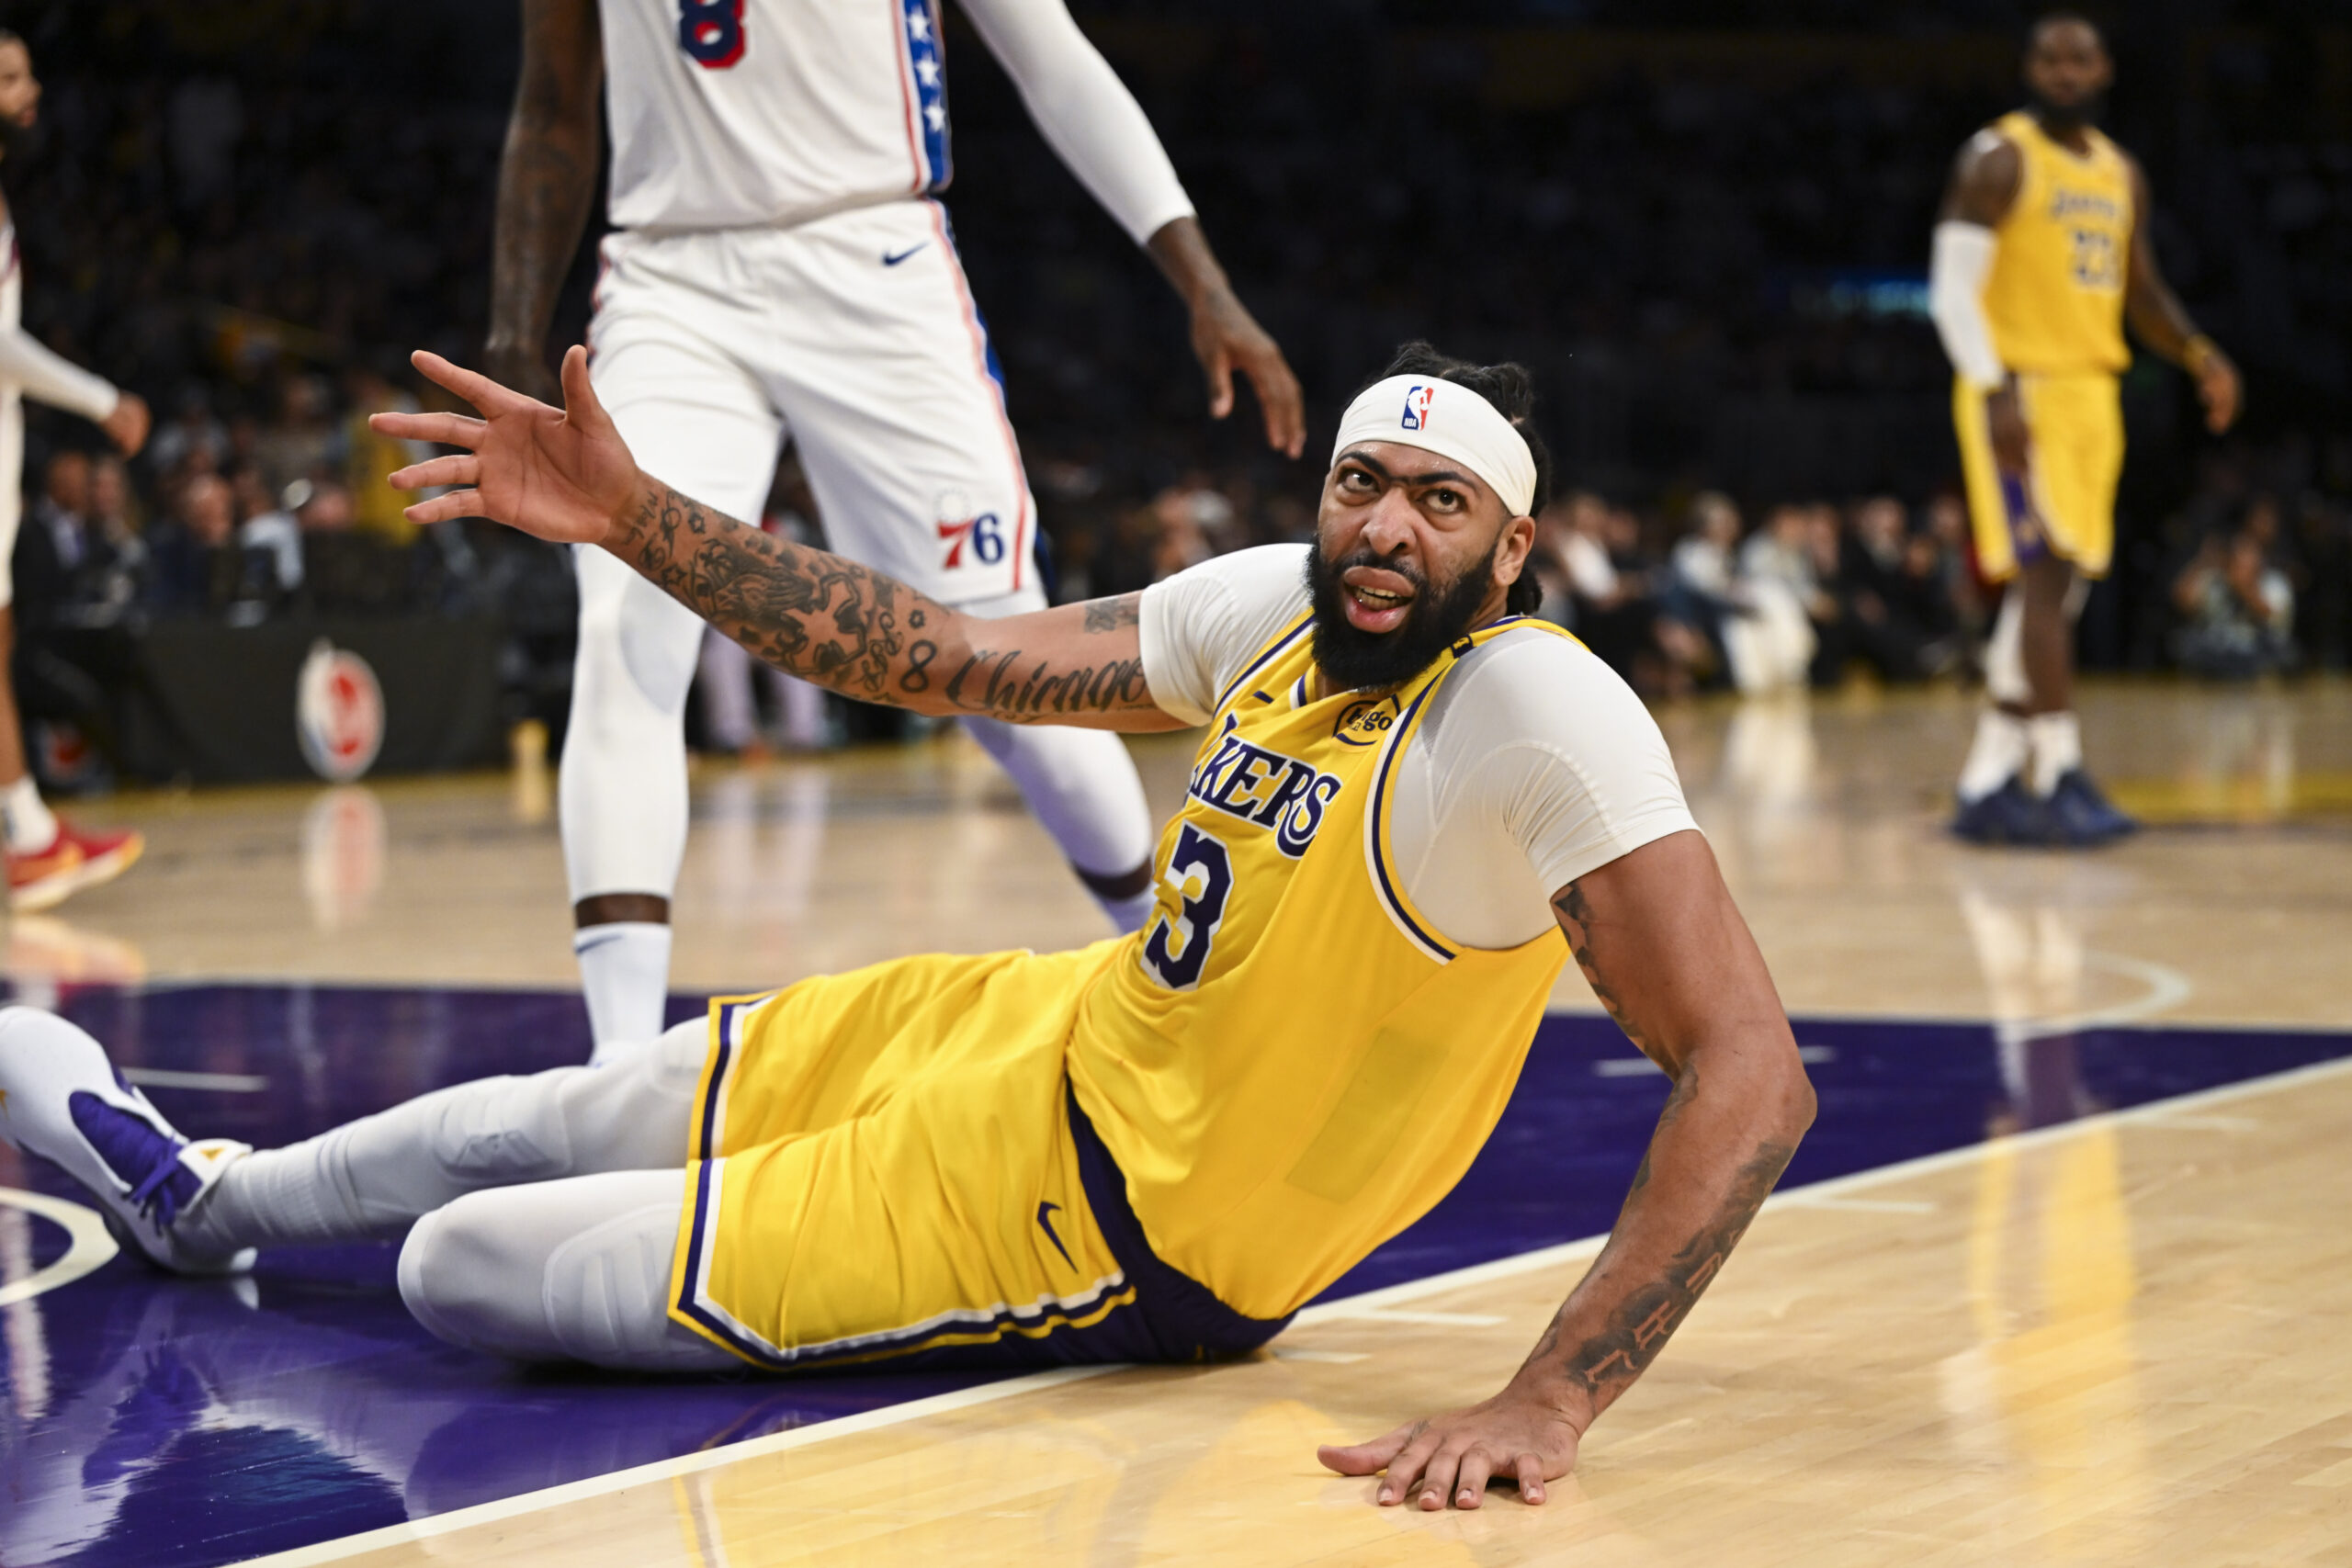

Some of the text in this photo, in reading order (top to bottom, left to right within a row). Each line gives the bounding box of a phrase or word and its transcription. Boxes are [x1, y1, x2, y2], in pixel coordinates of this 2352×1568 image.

[1404, 417, 1417, 428] NBA
[937, 512, 1006, 570] 76
[1142, 818, 1234, 990] 3
